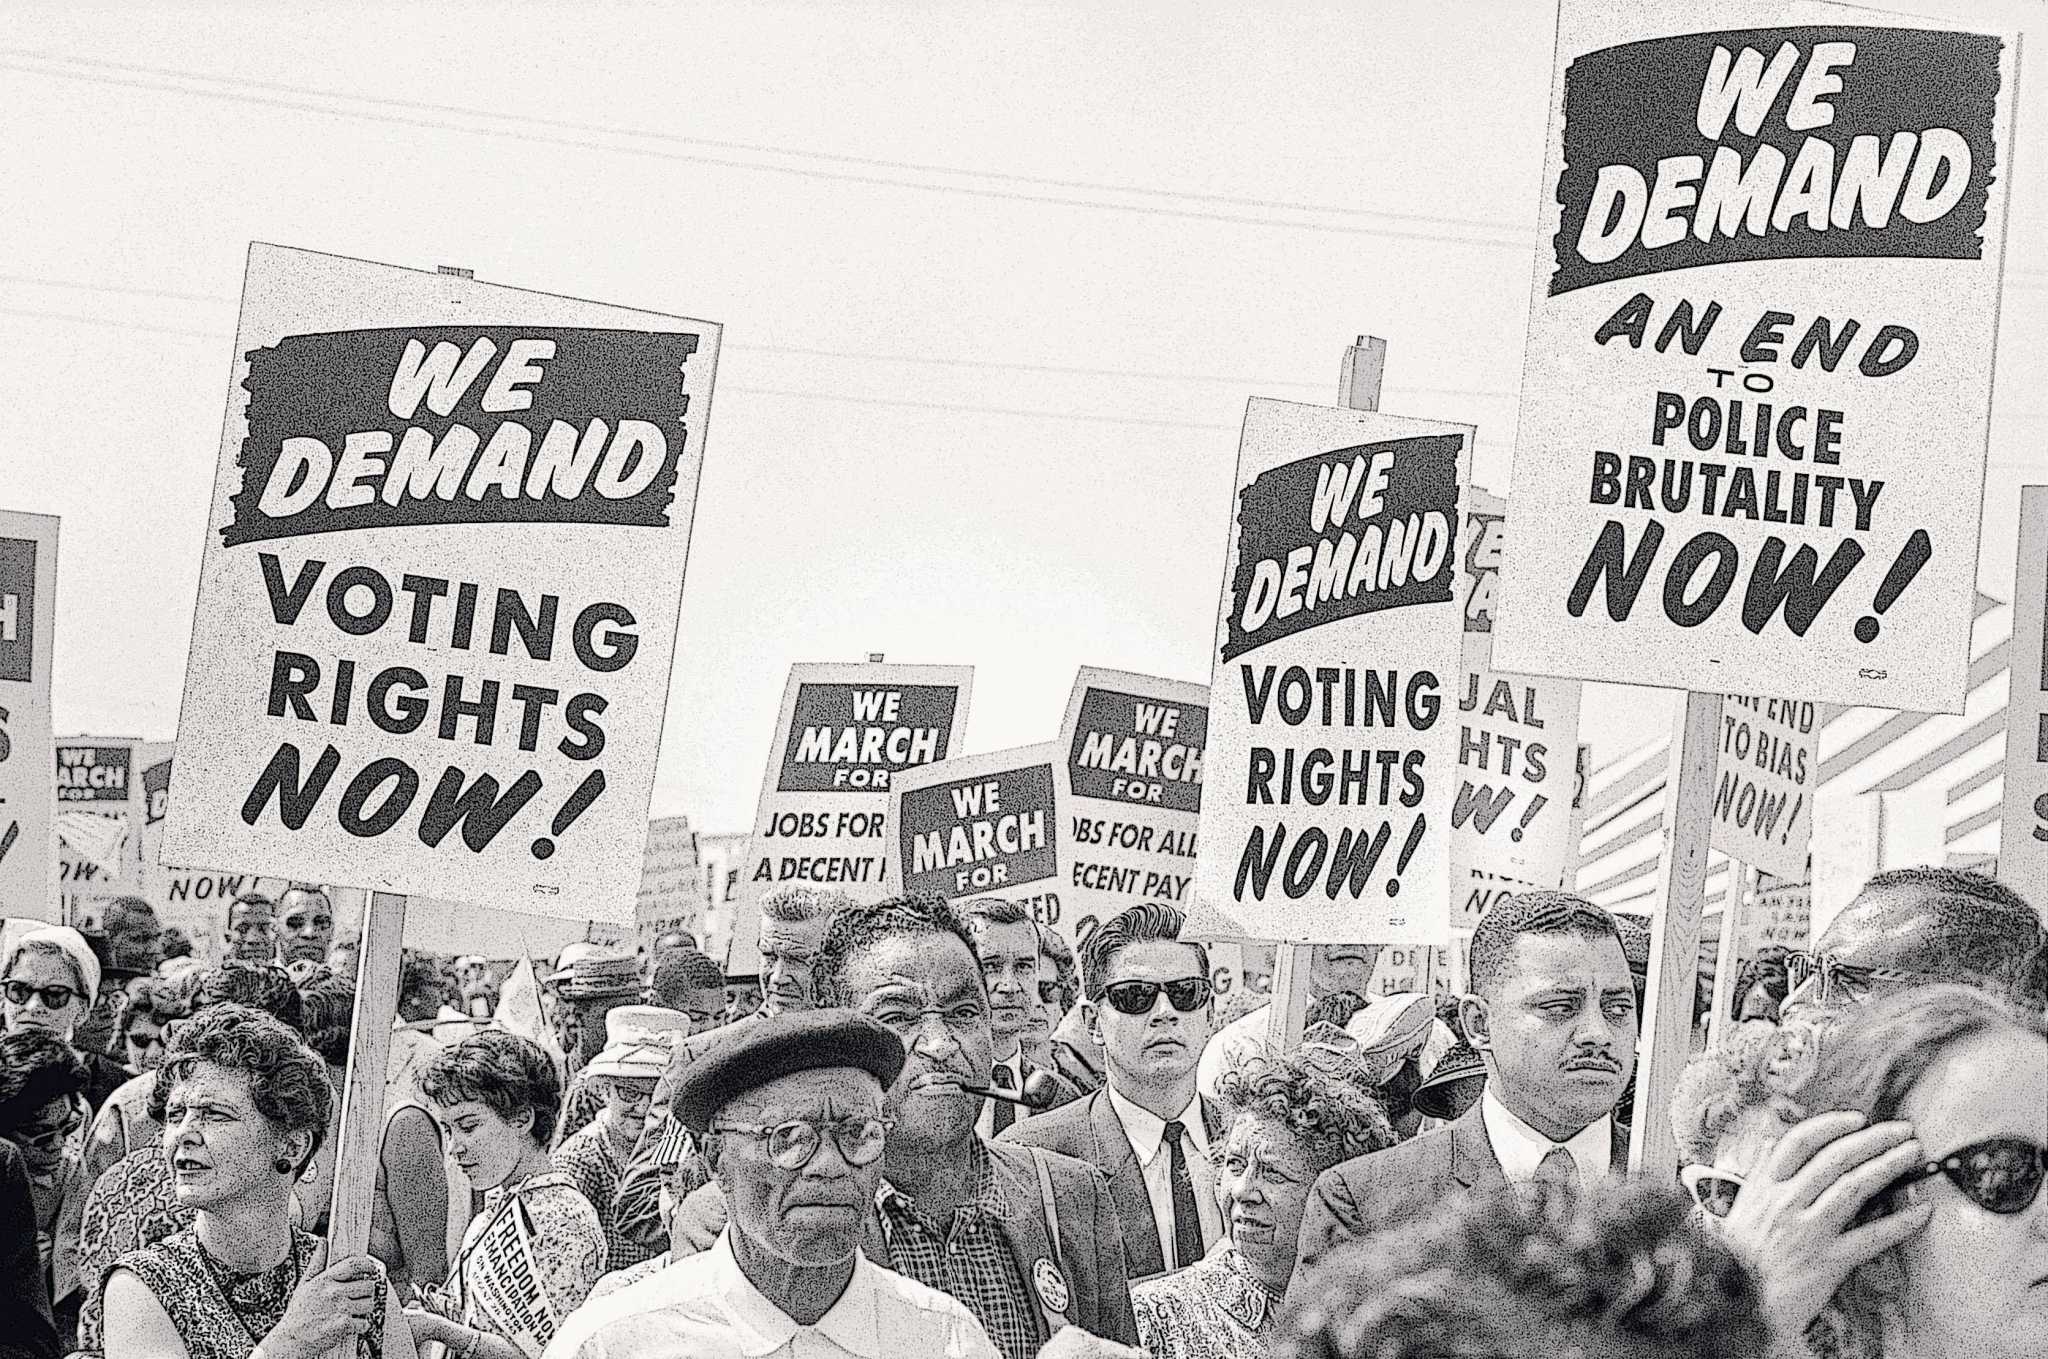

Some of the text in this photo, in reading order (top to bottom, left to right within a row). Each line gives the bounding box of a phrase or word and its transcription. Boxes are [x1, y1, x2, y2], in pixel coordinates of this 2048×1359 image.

[1697, 40, 1858, 140] WE
[1576, 127, 1973, 263] DEMAND
[1595, 293, 1919, 378] AN END
[388, 335, 556, 419] WE
[1707, 368, 1774, 393] TO
[1652, 391, 1845, 465] POLICE
[258, 417, 667, 518] DEMAND
[1311, 451, 1394, 533] WE
[1589, 450, 1885, 531] BRUTALITY
[1240, 511, 1449, 633] DEMAND
[1566, 519, 1932, 642] NOW!
[258, 552, 639, 672] VOTING
[267, 650, 609, 760] RIGHTS
[853, 691, 902, 722] WE
[1134, 703, 1180, 738] WE
[1240, 664, 1441, 731] VOTING
[57, 765, 124, 789] ARCH
[794, 726, 939, 764] MARCH
[833, 769, 889, 788] FOR
[1077, 731, 1204, 784] MARCH
[1246, 747, 1426, 808] RIGHTS
[1725, 715, 1807, 785] TO BIAS
[241, 742, 606, 860] NOW!
[951, 782, 1001, 820] WE
[1111, 778, 1164, 803] FOR
[1713, 770, 1803, 845] NOW!
[764, 813, 884, 838] JOBS FOR
[913, 809, 1046, 875] MARCH
[1072, 816, 1198, 859] BS FOR ALL
[1234, 813, 1426, 902] NOW!
[752, 857, 772, 882] A
[777, 857, 873, 882] DECENT
[955, 862, 1009, 892] FOR
[1144, 870, 1194, 901] PAY
[484, 1231, 538, 1333] EMANCIPATION
[495, 1206, 540, 1306] FREEDOM
[484, 1271, 524, 1333] WASHINGTON
